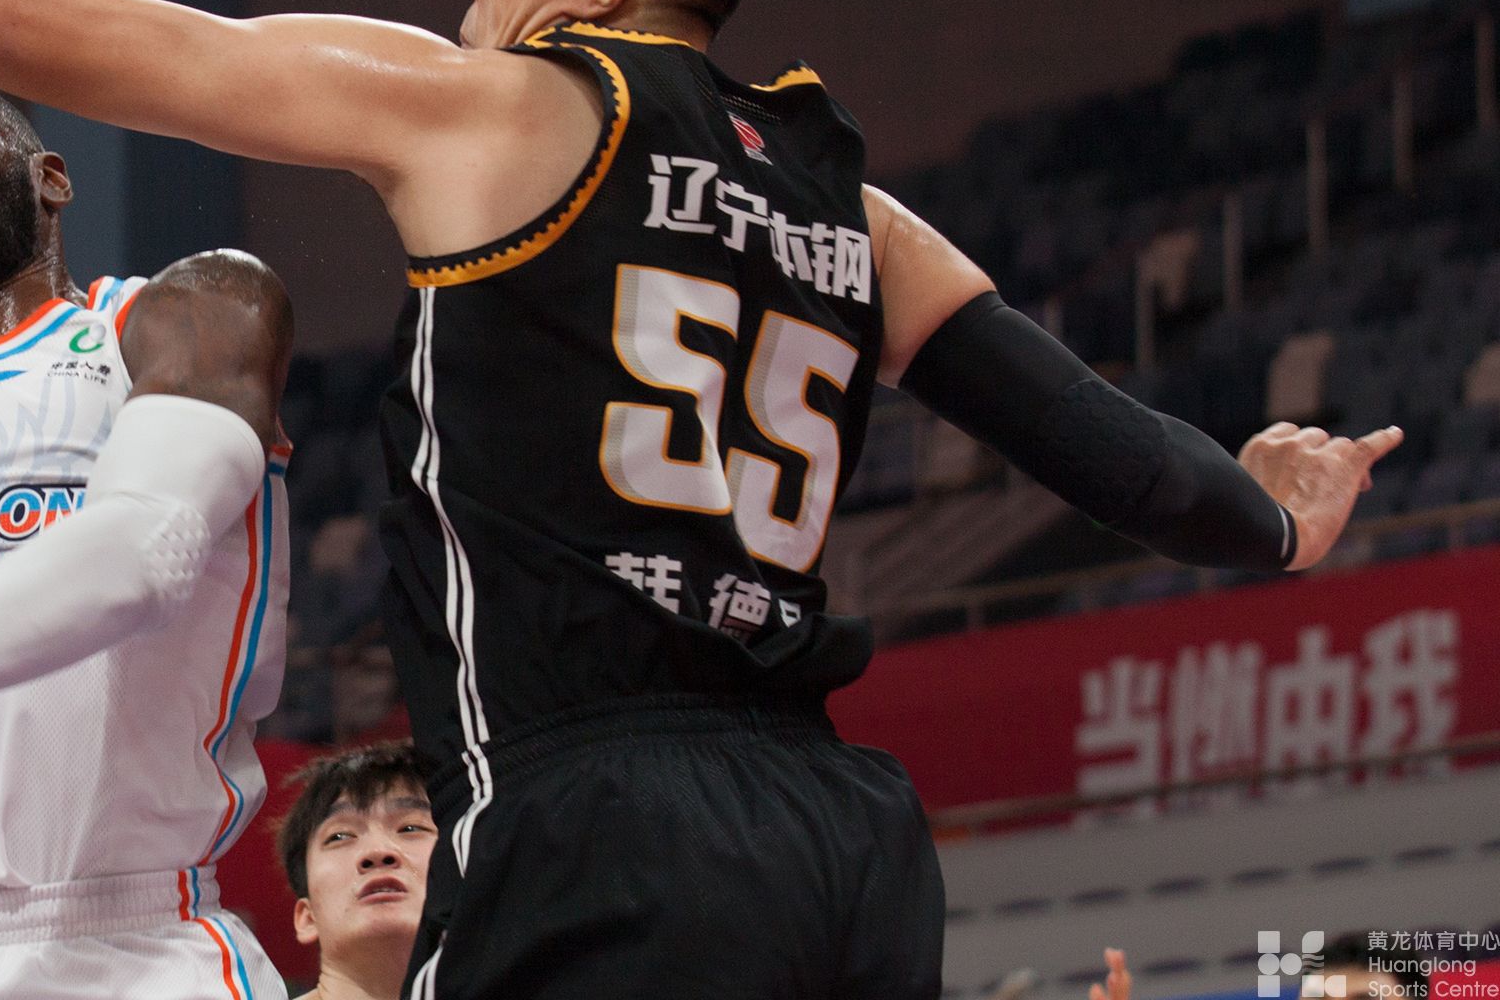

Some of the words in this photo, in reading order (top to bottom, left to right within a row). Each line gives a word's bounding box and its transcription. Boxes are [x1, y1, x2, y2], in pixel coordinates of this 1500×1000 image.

[644, 154, 871, 304] 辽宁本钢
[84, 373, 108, 385] LIFE
[600, 263, 860, 574] 55
[604, 552, 803, 645] 韩德
